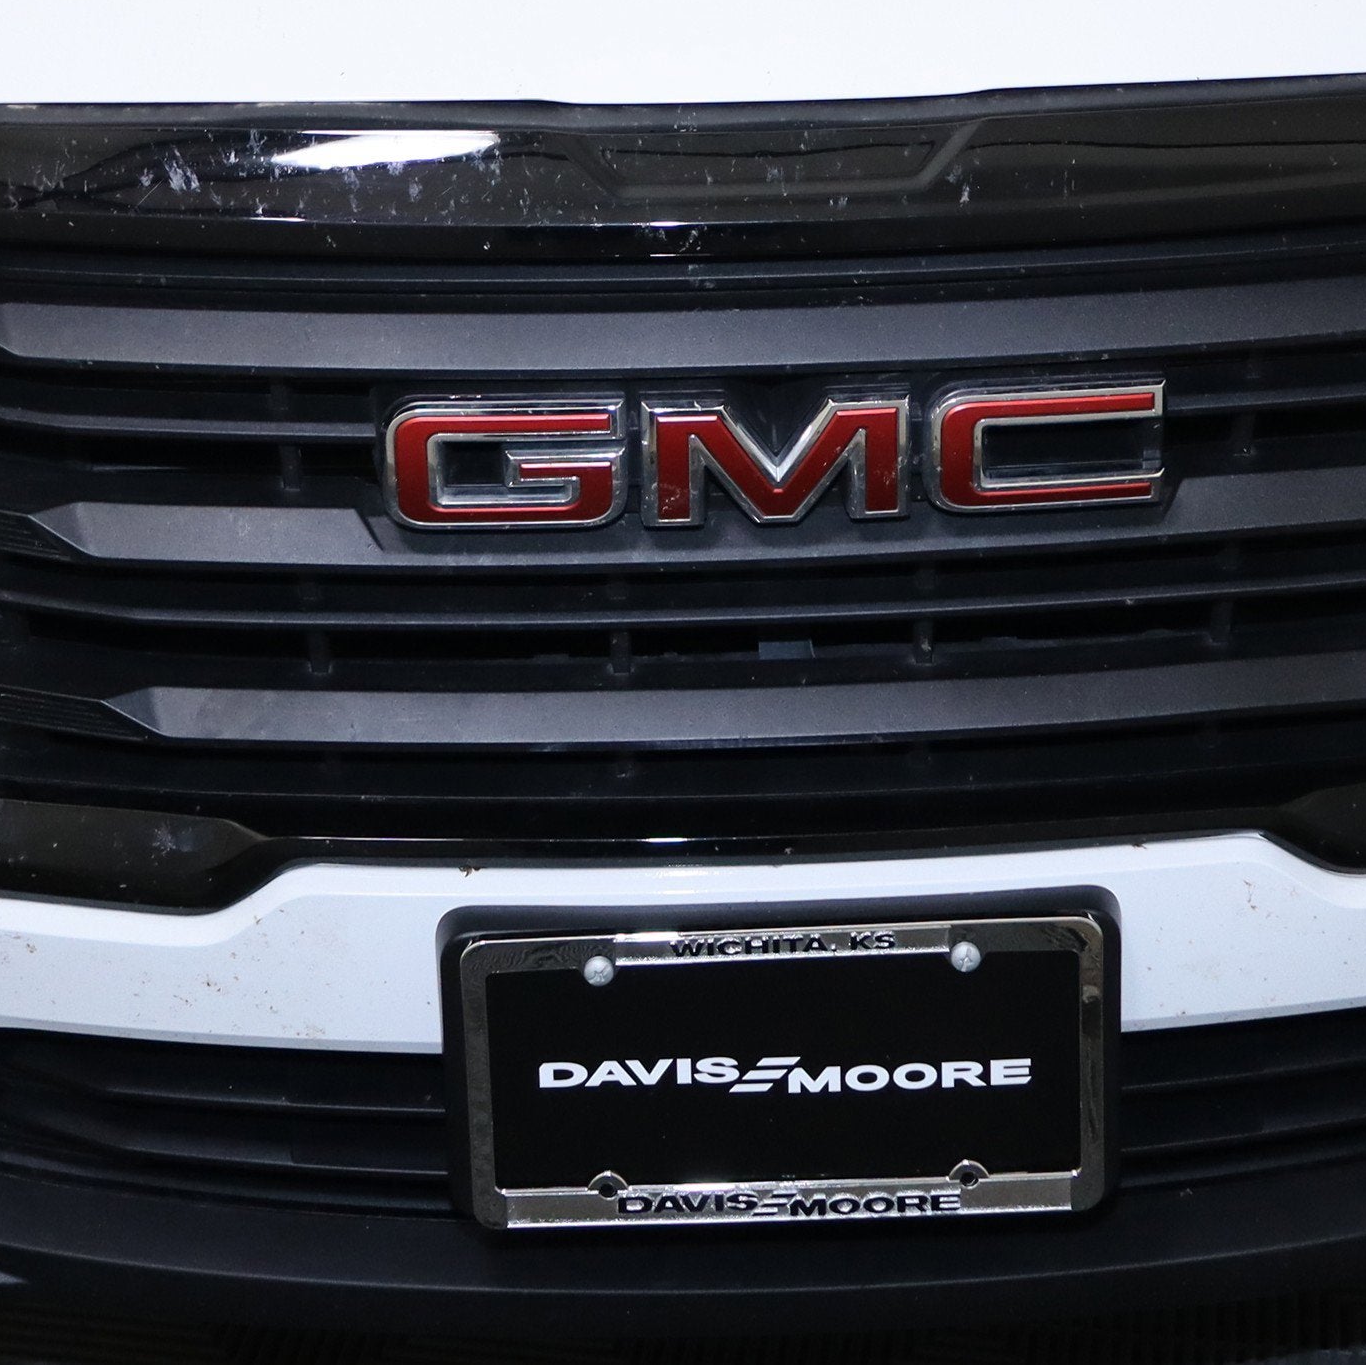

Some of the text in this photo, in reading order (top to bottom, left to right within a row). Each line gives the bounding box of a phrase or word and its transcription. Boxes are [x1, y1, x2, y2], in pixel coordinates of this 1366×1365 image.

[383, 380, 1166, 527] GMC
[849, 931, 897, 951] KS
[539, 1057, 1032, 1094] DAVIS MOORE
[617, 1192, 961, 1217] DAVIS MOORE
